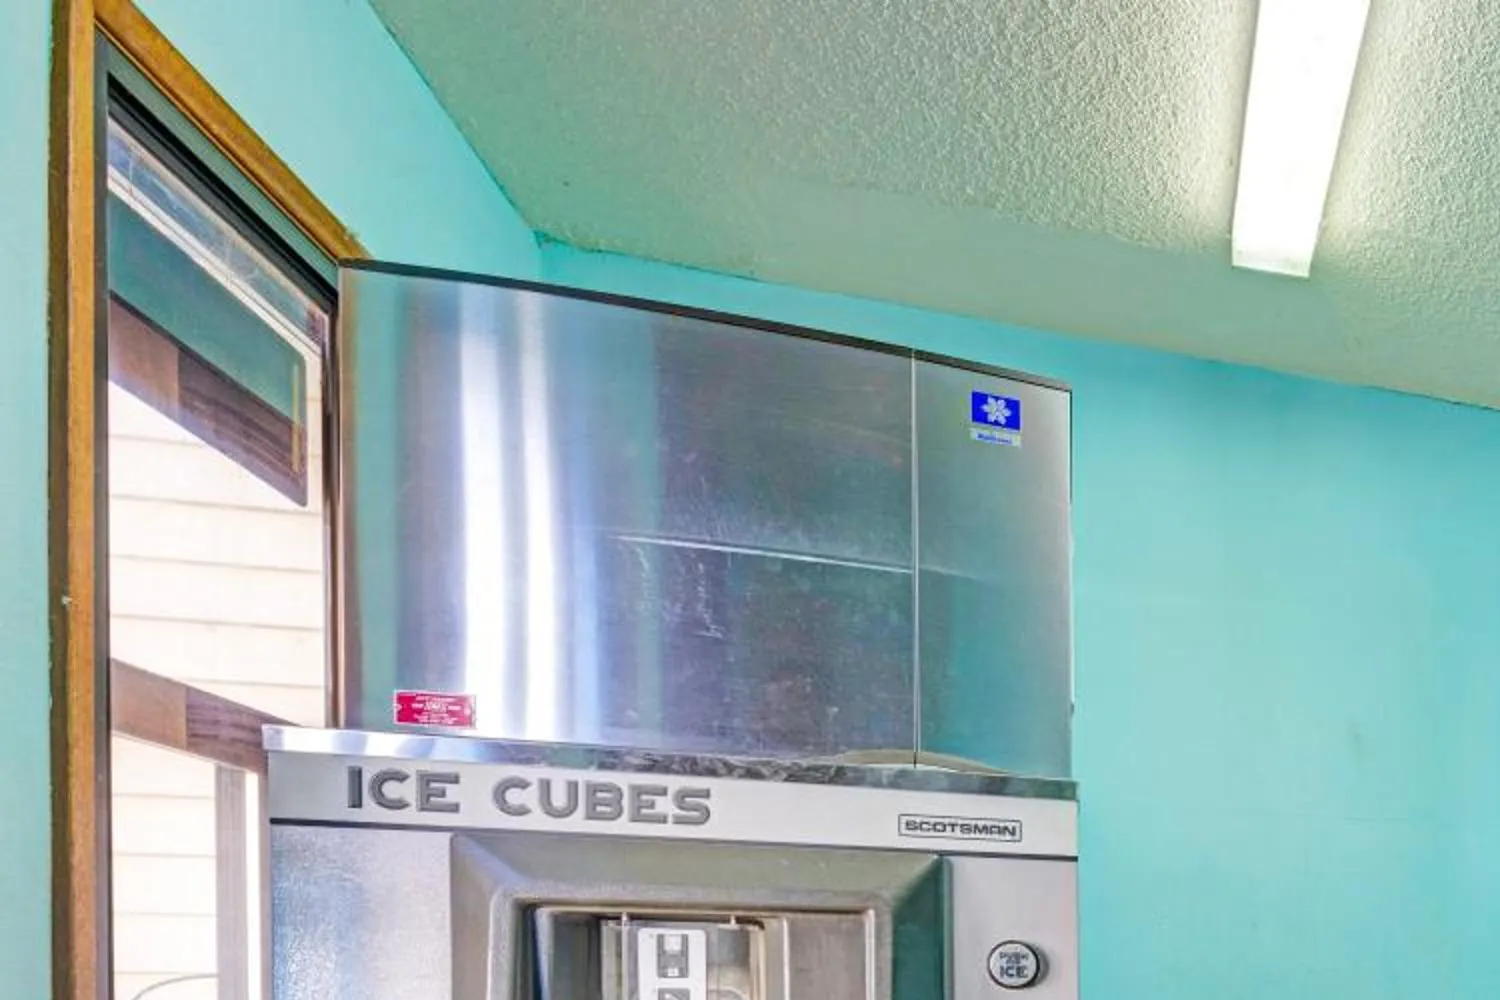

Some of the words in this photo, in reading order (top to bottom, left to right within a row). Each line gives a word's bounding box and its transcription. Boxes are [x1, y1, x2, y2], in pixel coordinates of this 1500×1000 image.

[347, 766, 461, 814] ICE
[493, 774, 712, 826] CUBES
[905, 819, 1017, 837] SCOTSMAN
[999, 965, 1029, 978] ICE
